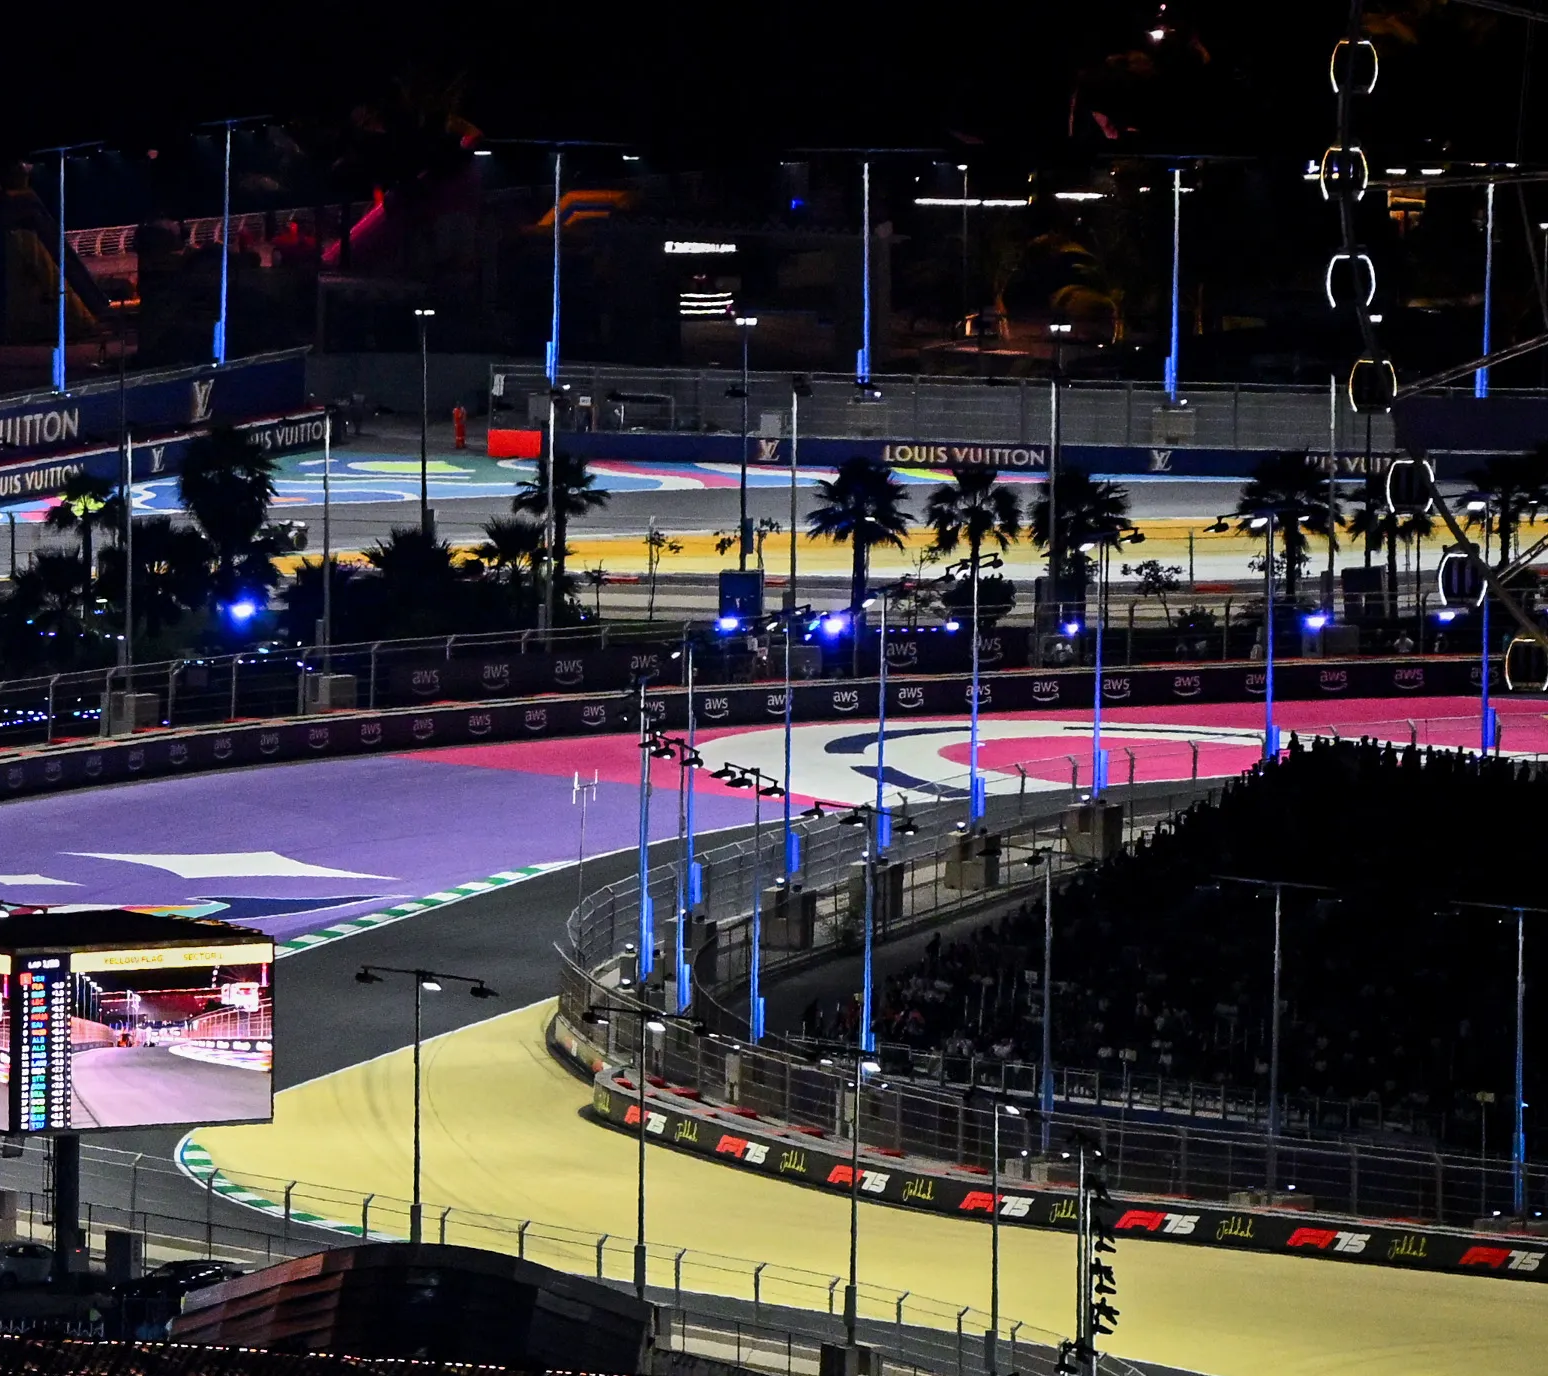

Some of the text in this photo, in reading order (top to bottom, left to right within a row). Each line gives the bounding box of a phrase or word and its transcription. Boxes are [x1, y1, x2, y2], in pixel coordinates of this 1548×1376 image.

[885, 443, 1045, 465] LOUIS VUITTON
[741, 1142, 770, 1164] 75
[860, 1170, 890, 1193] 75
[1000, 1195, 1034, 1217] 75
[1161, 1214, 1200, 1235] 75
[1333, 1230, 1372, 1252] 75
[1507, 1250, 1546, 1271] 75
